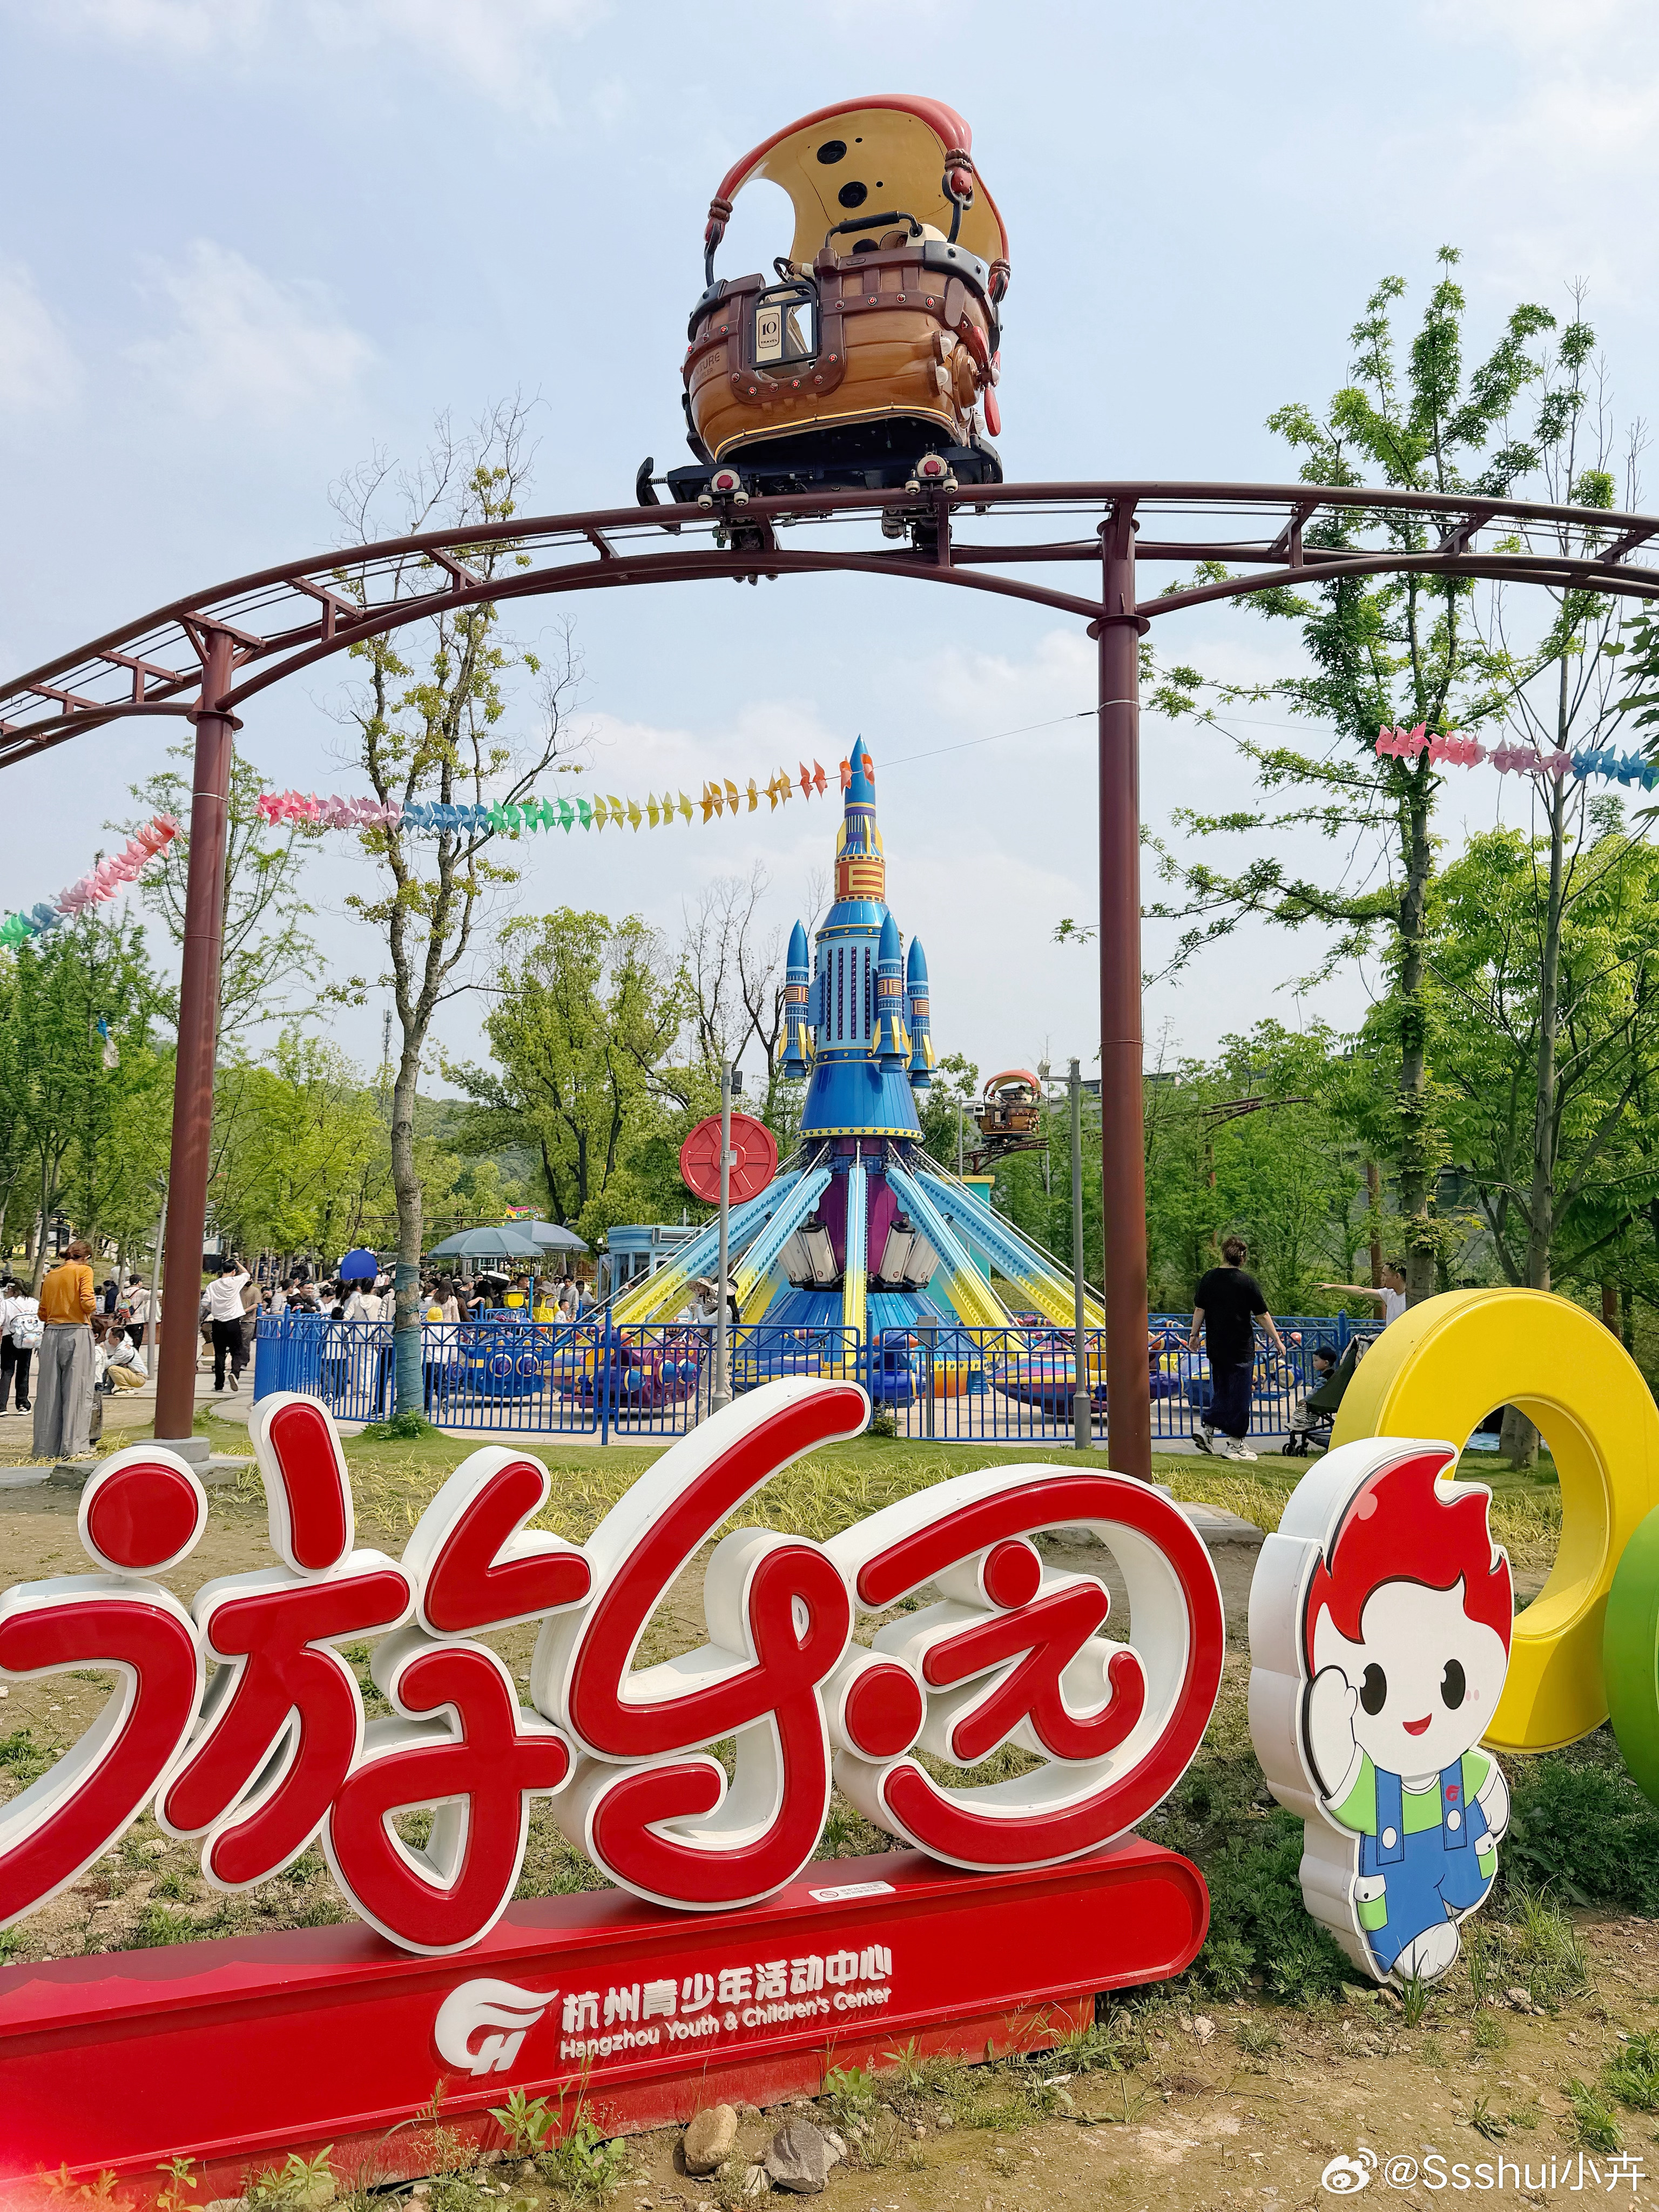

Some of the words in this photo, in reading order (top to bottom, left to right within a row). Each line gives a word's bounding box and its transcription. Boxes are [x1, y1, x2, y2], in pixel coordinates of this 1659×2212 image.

[762, 321, 777, 335] 10
[0, 1377, 1226, 1956] 游乐园
[560, 2028, 659, 2060] Hangzhou
[665, 2014, 719, 2041] Youth
[724, 2011, 738, 2031] &
[741, 1996, 830, 2027] Children's
[833, 1987, 892, 2011] Center
[562, 1944, 892, 2033] 杭州青少年活动中心
